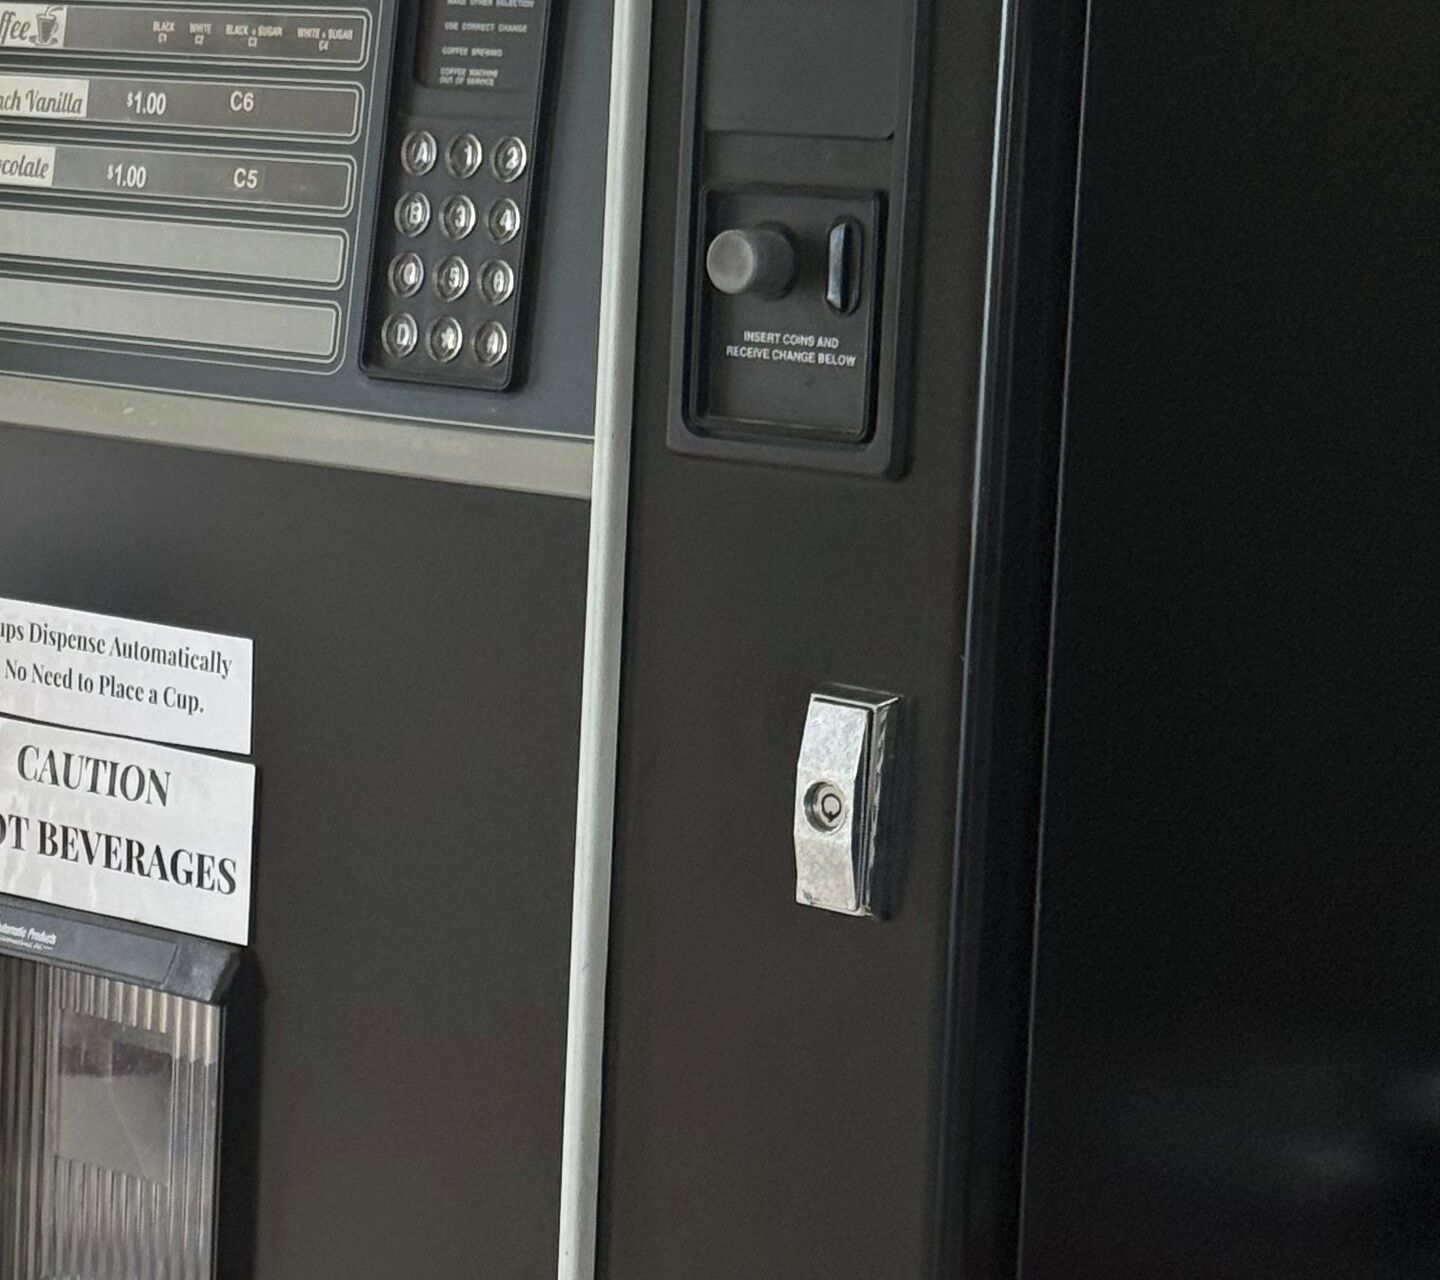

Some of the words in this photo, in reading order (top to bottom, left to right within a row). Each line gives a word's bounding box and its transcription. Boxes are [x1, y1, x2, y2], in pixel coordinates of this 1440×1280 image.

[153, 21, 175, 33] BLACK
[226, 24, 249, 36] BLACK
[25, 89, 83, 115] Vanilla
[126, 91, 167, 115] $1.00
[229, 91, 254, 113] C6
[415, 141, 428, 164] A
[506, 146, 520, 170] 2
[107, 165, 147, 189] $1.00
[233, 168, 258, 189] C5
[409, 201, 422, 225] B
[454, 204, 466, 228] 3
[743, 330, 781, 345] INSERT
[782, 333, 815, 348] COINS
[817, 335, 840, 349] AND
[726, 346, 770, 360] RECEIVE
[772, 349, 816, 364] CHANGE
[817, 351, 857, 367] BELOW
[28, 622, 106, 655] Dispense
[108, 635, 233, 680] Automatically
[4, 657, 28, 683] No
[30, 664, 73, 690] Need
[77, 672, 95, 694] to
[98, 674, 146, 703] Place
[148, 690, 158, 706] a
[162, 685, 205, 717] Cup.
[17, 743, 172, 809] CAUTION
[36, 817, 237, 896] BEVERAGES
